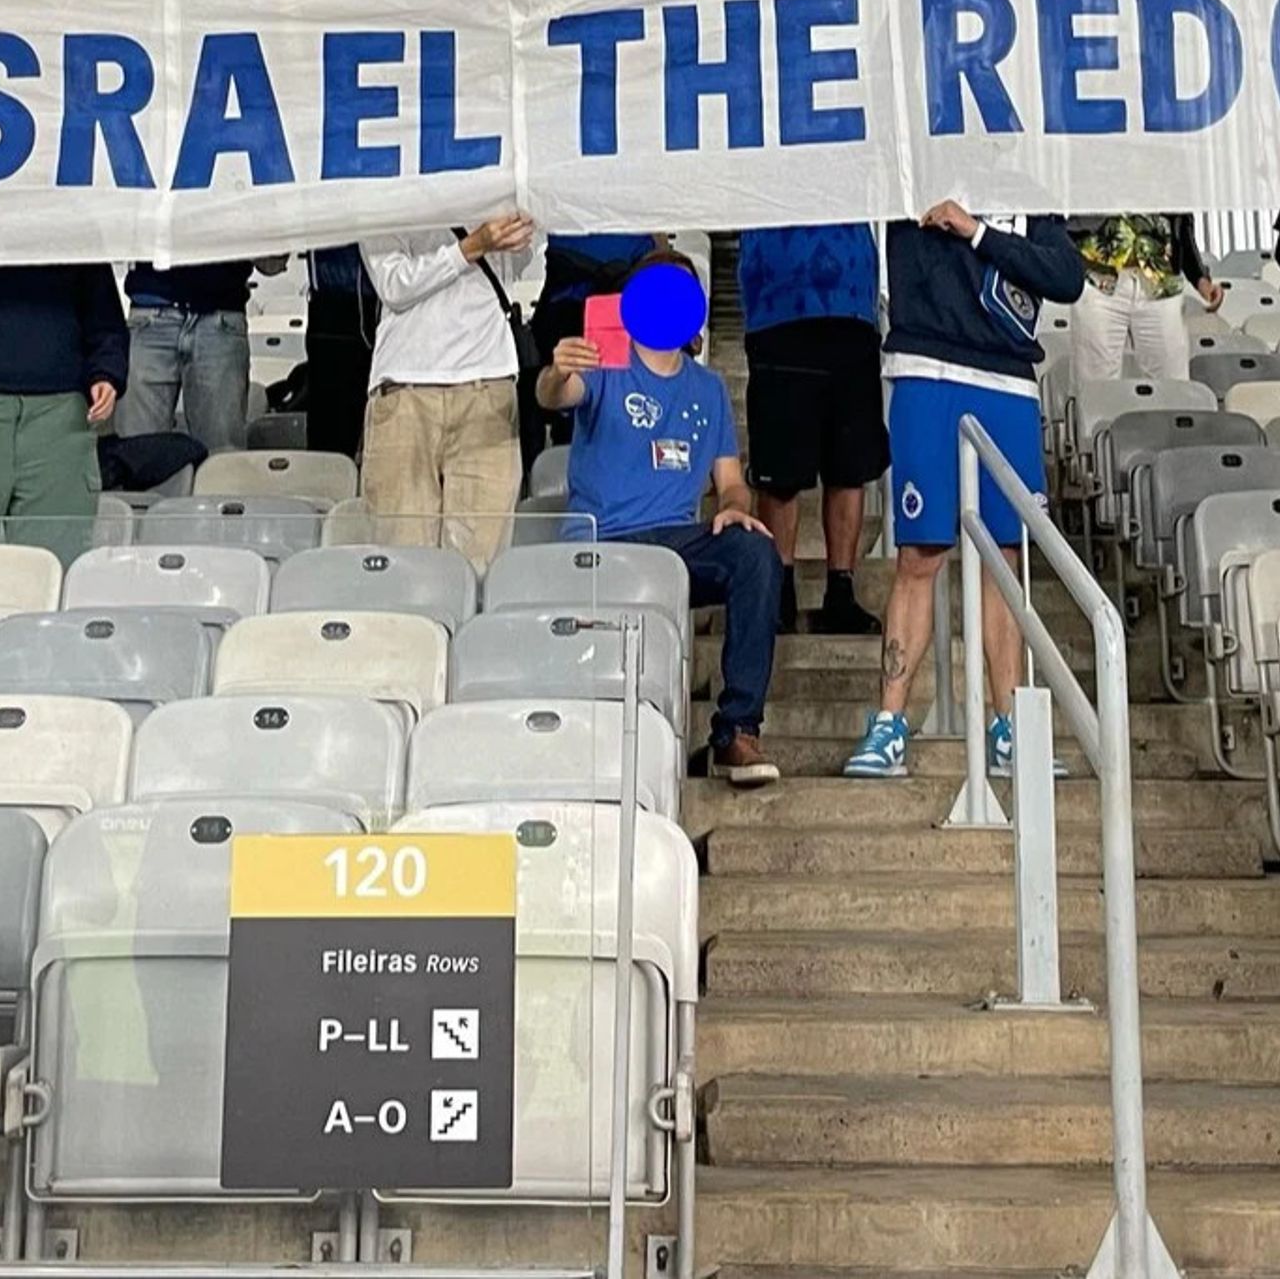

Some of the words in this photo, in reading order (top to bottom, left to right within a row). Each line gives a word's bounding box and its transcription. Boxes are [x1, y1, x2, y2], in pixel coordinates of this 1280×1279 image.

[263, 712, 280, 725] 14
[325, 846, 426, 897] 120
[322, 950, 417, 973] Fileiras
[426, 954, 479, 973] Rows
[318, 1018, 409, 1052] P-LL
[323, 1100, 407, 1134] A-O
